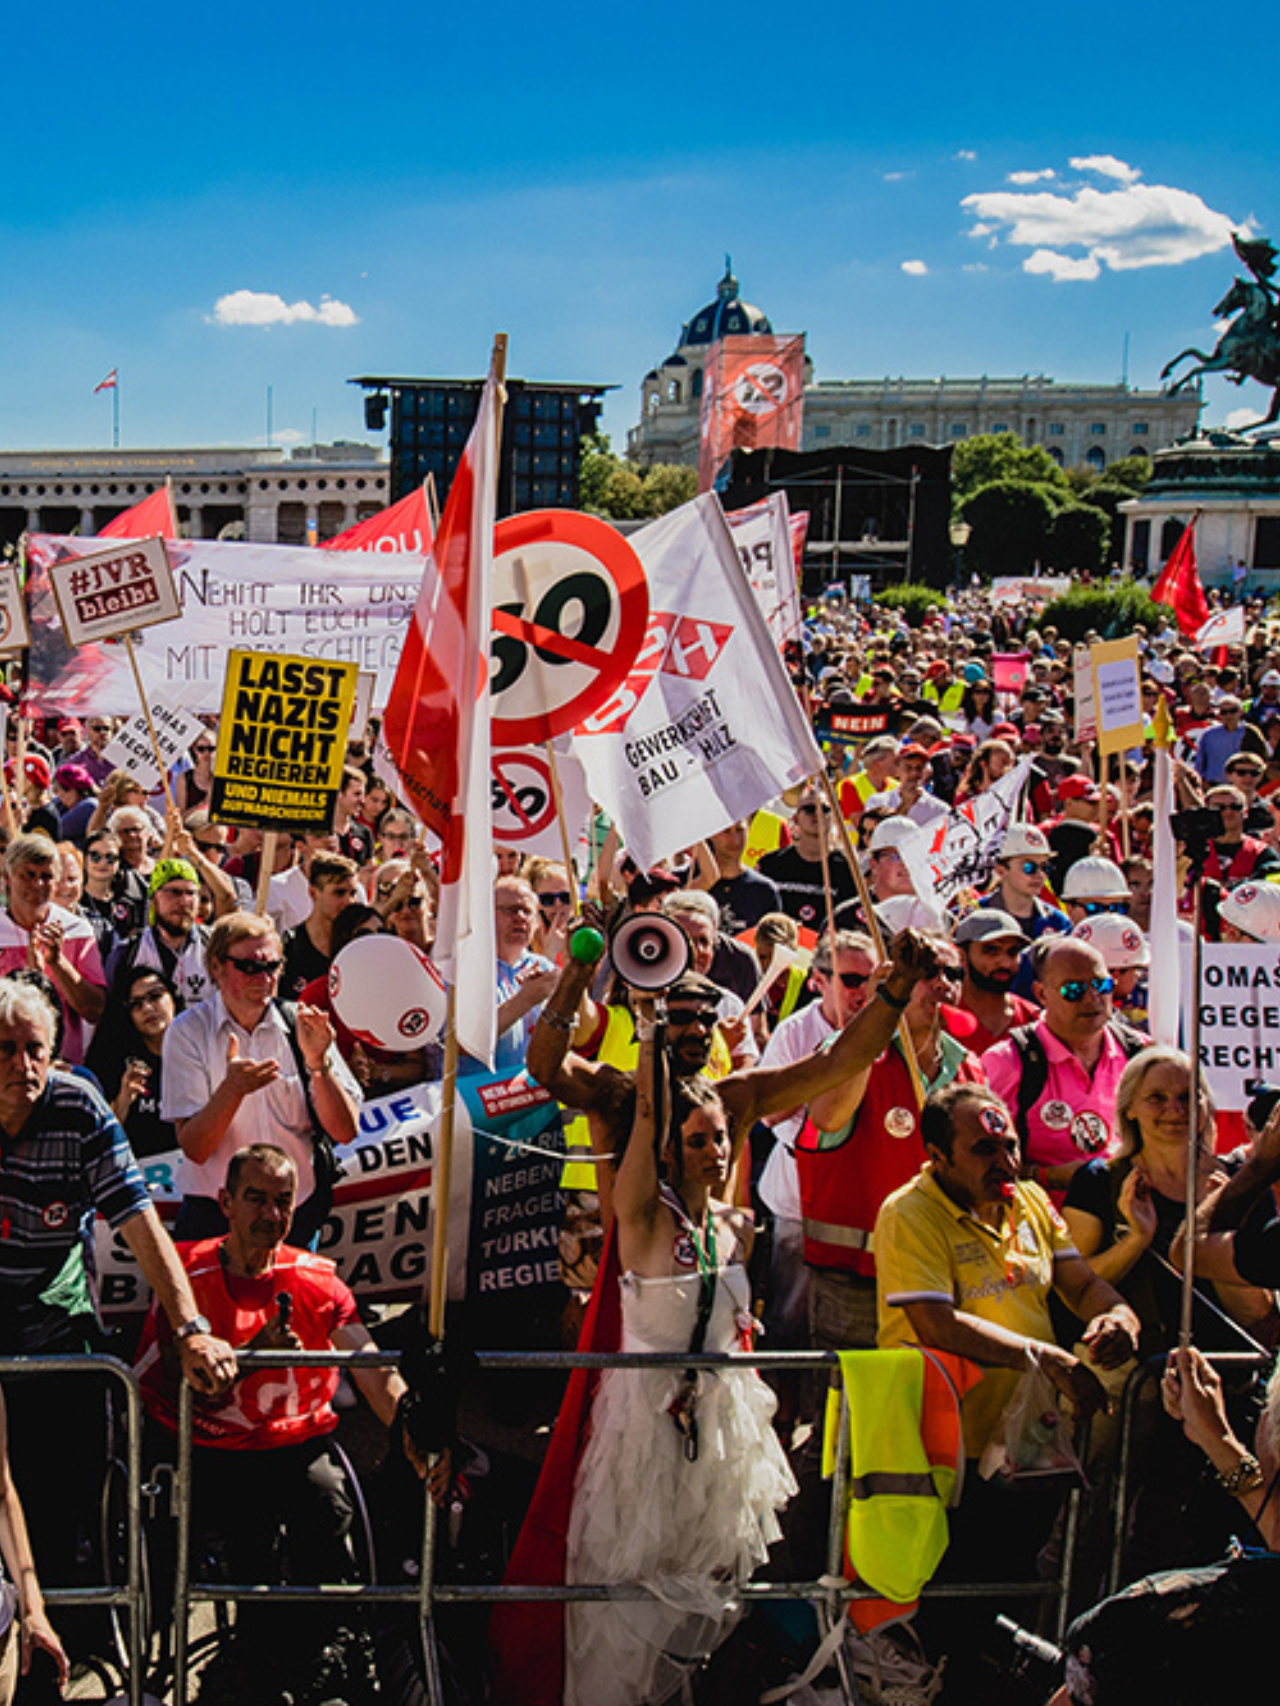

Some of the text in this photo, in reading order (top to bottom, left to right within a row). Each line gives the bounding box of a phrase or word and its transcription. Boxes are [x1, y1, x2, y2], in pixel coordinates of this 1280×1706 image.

[79, 582, 156, 620] bleibt
[299, 581, 343, 605] IHR
[229, 609, 292, 637] HOLT
[305, 606, 370, 635] EUCH
[166, 644, 217, 680] MIT
[239, 657, 347, 698] LASST
[150, 703, 190, 737] OMAS
[234, 689, 341, 731] NAZIS
[834, 716, 884, 732] NEIN
[133, 717, 178, 756] GEEN
[231, 723, 338, 764] NICHT
[226, 755, 332, 785] REGIEREN
[637, 759, 680, 796] BAU
[225, 782, 328, 808] UND NIEMALS
[492, 779, 547, 818] 60
[358, 1097, 422, 1134] UE
[355, 1131, 433, 1173] DEN
[479, 1260, 560, 1293] REGIE
